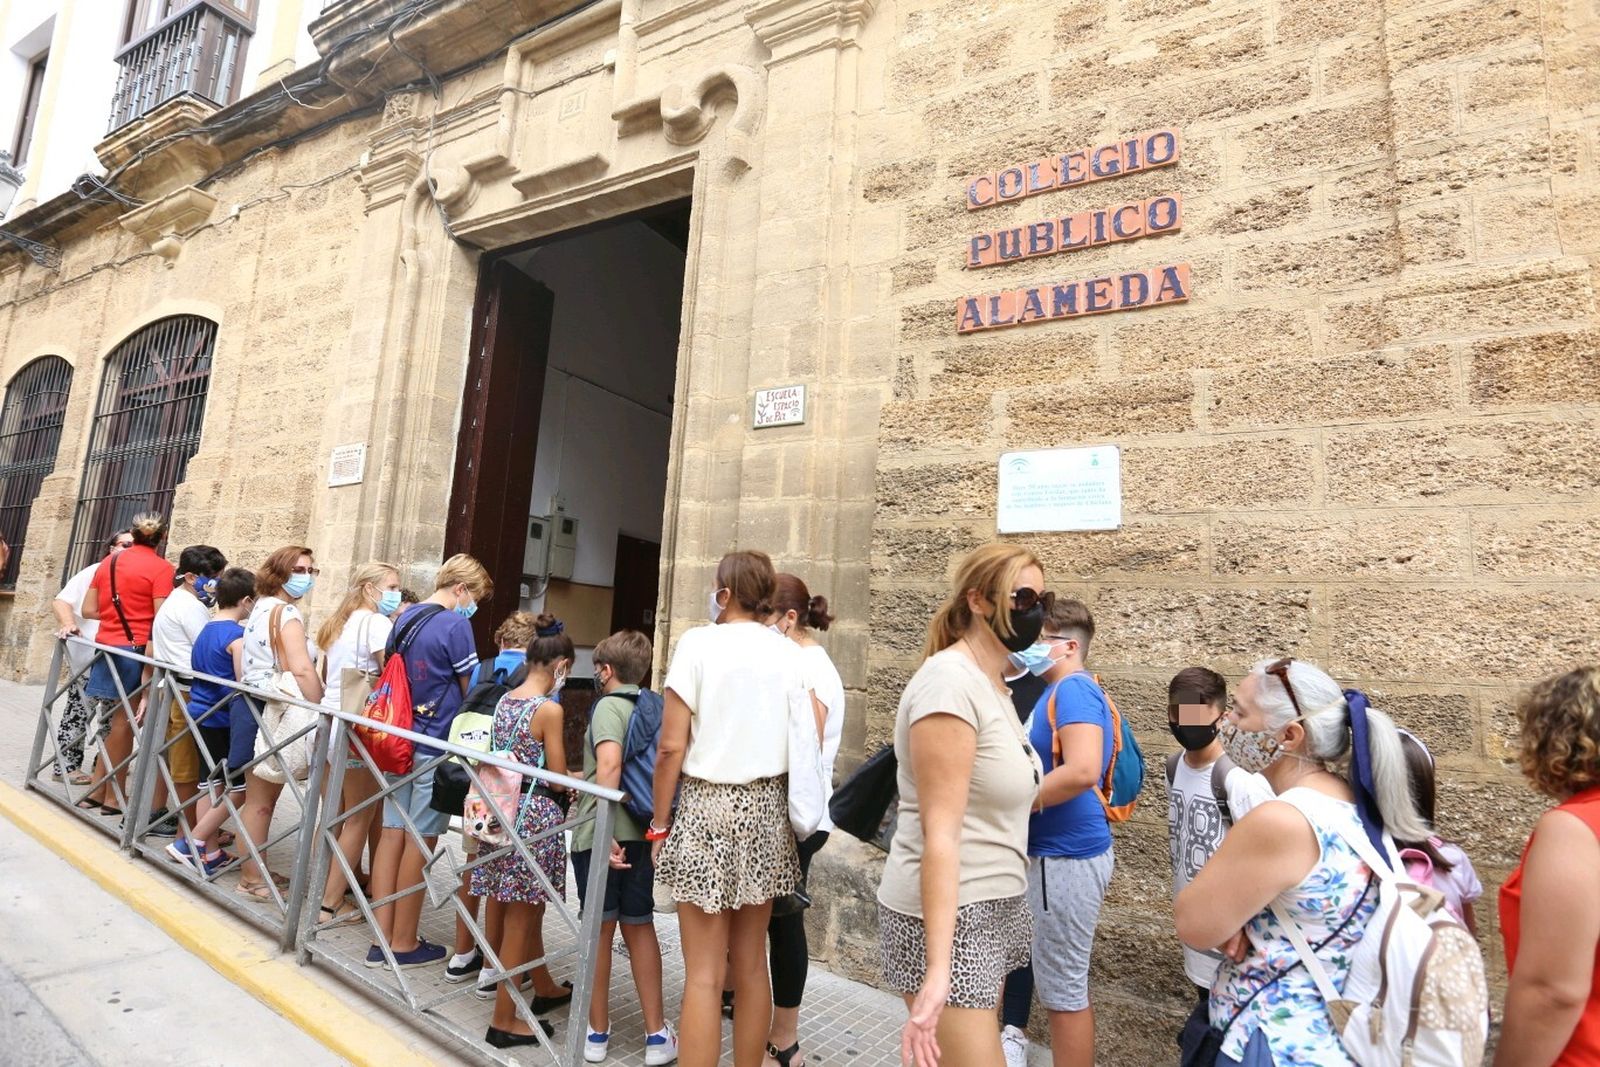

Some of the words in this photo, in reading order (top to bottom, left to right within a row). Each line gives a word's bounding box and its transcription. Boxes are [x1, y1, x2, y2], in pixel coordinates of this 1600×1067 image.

[969, 131, 1176, 206] COLEGIO
[969, 197, 1178, 266] PUBLICO
[959, 266, 1187, 330] ALAMEDA
[766, 389, 797, 402] ESCUELA
